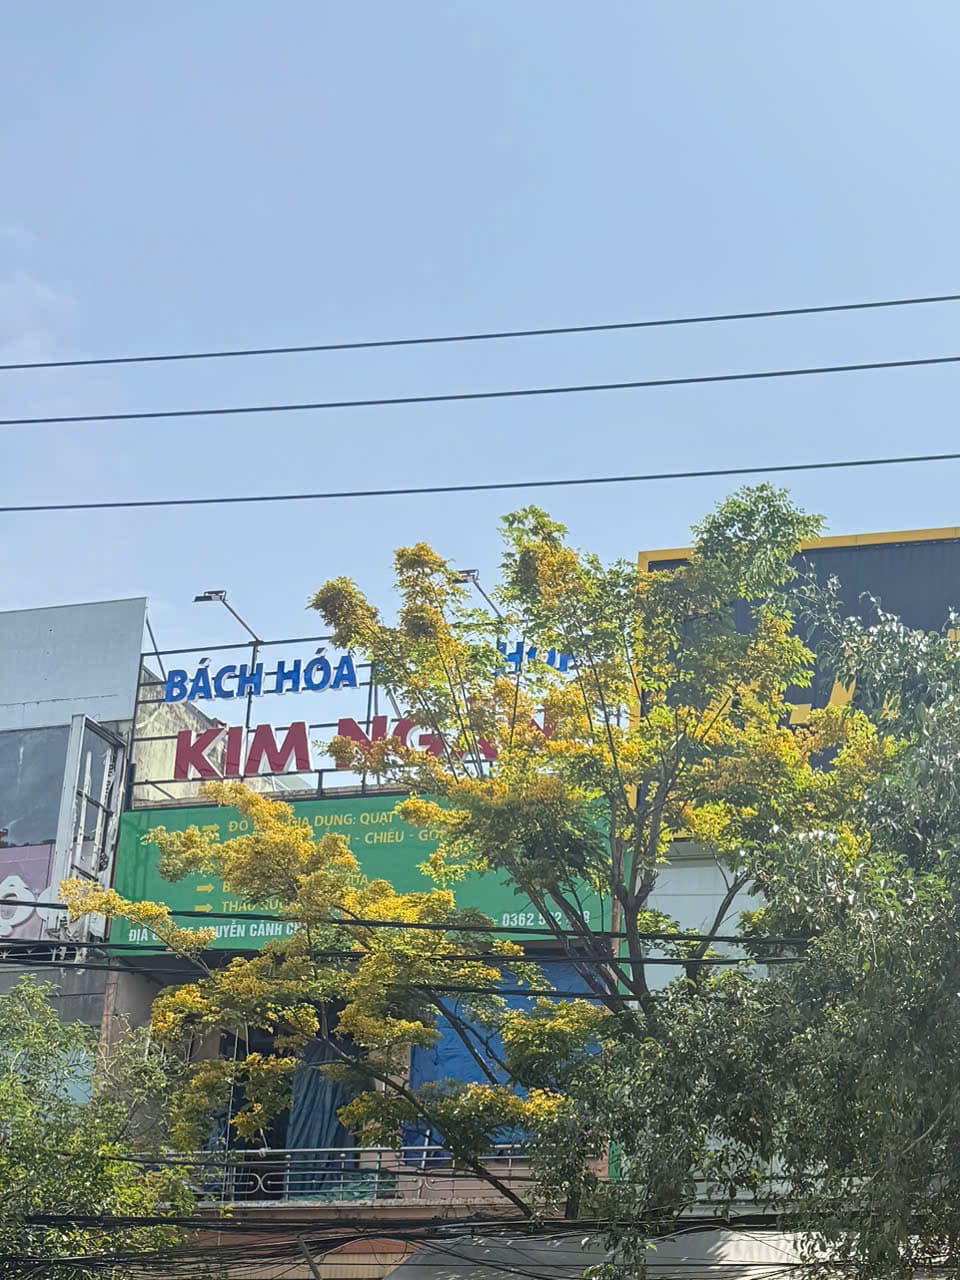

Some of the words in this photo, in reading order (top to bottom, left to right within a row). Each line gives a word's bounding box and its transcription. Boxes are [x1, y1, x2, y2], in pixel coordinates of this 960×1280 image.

[165, 657, 263, 703] BÁCH
[274, 647, 359, 694] HÓA
[173, 721, 314, 781] KIM
[314, 813, 356, 831] DỤNG:
[359, 812, 395, 826] QUẠT
[128, 928, 148, 944] ĐỊA
[249, 920, 283, 937] CẢNH
[502, 912, 534, 927] 0362
[538, 911, 562, 926] 52
